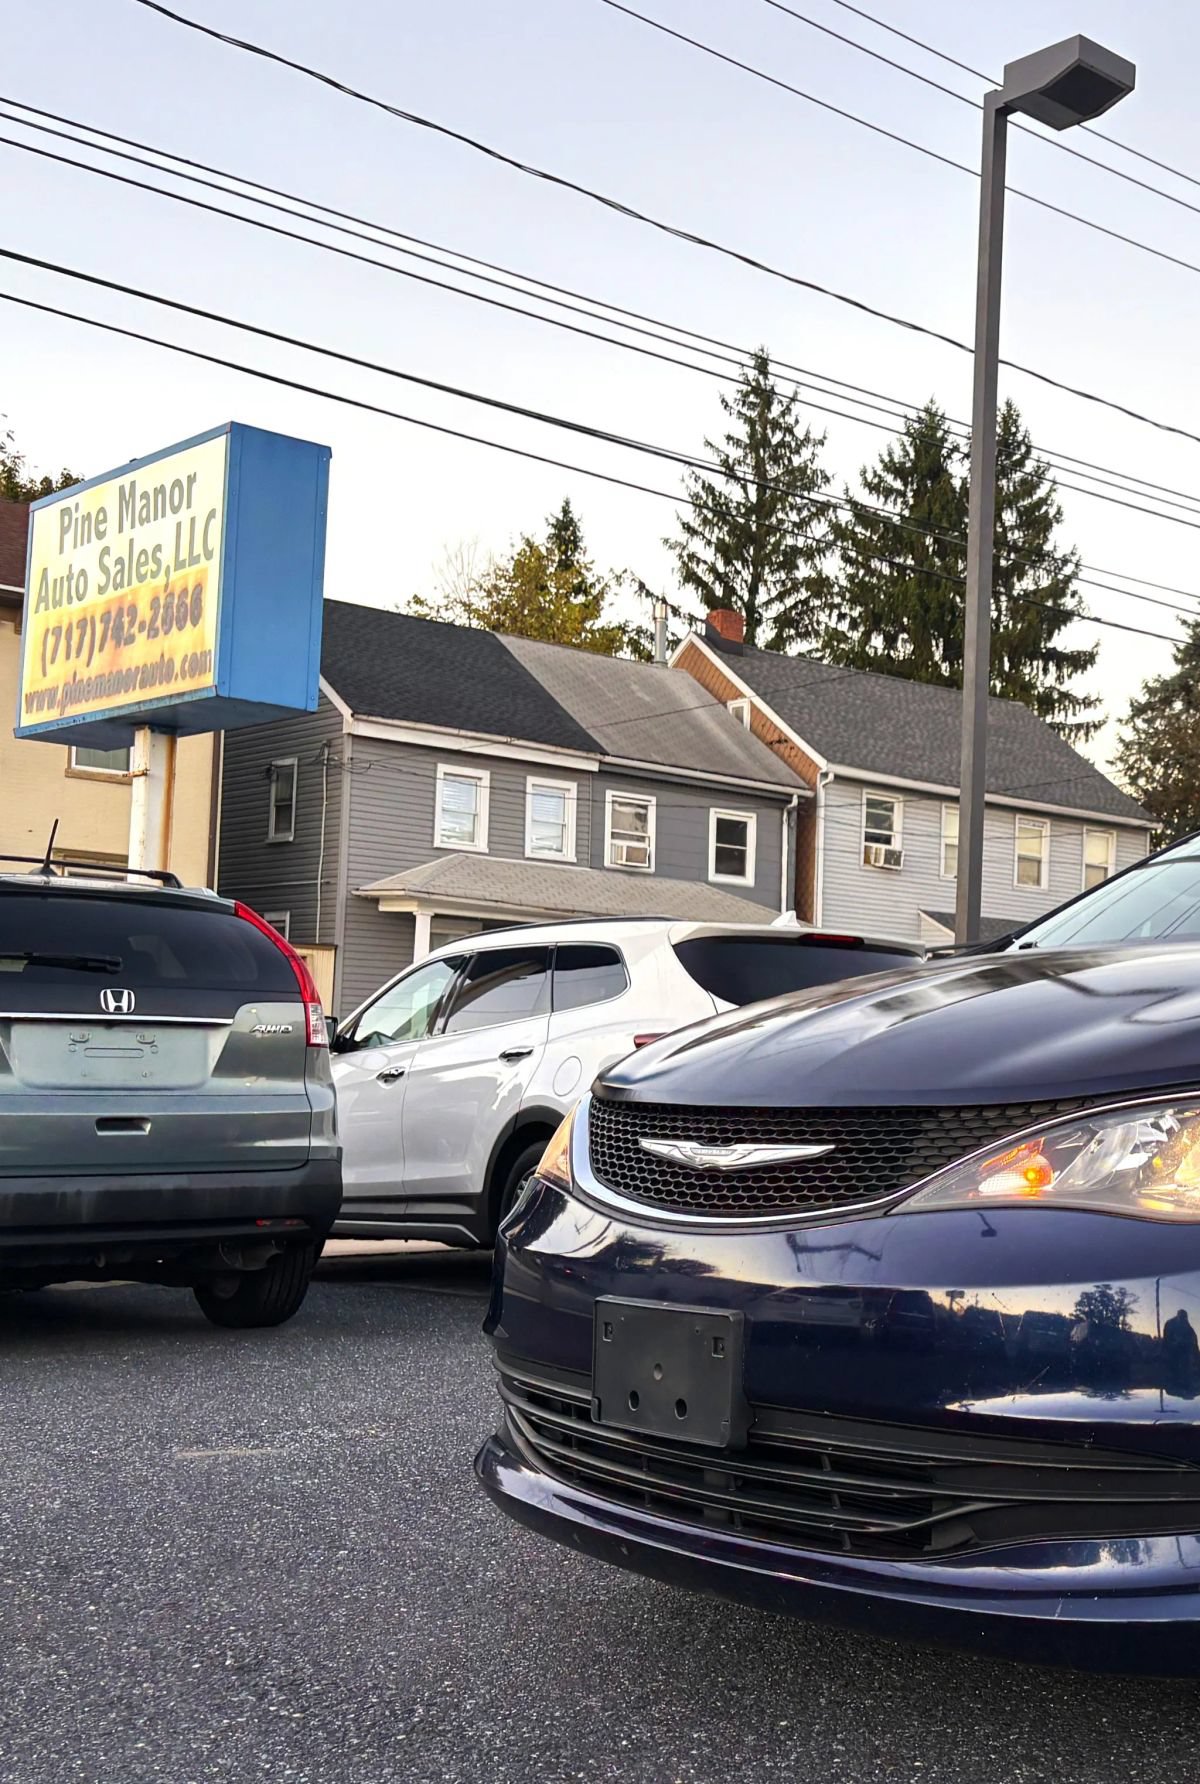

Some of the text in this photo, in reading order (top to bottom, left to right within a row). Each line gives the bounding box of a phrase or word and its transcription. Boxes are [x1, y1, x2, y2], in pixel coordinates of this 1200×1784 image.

[59, 472, 197, 555] Pine Manor
[34, 564, 88, 615] Auto
[25, 649, 212, 715] www.pinemanorauto.com
[249, 1024, 293, 1034] AWD
